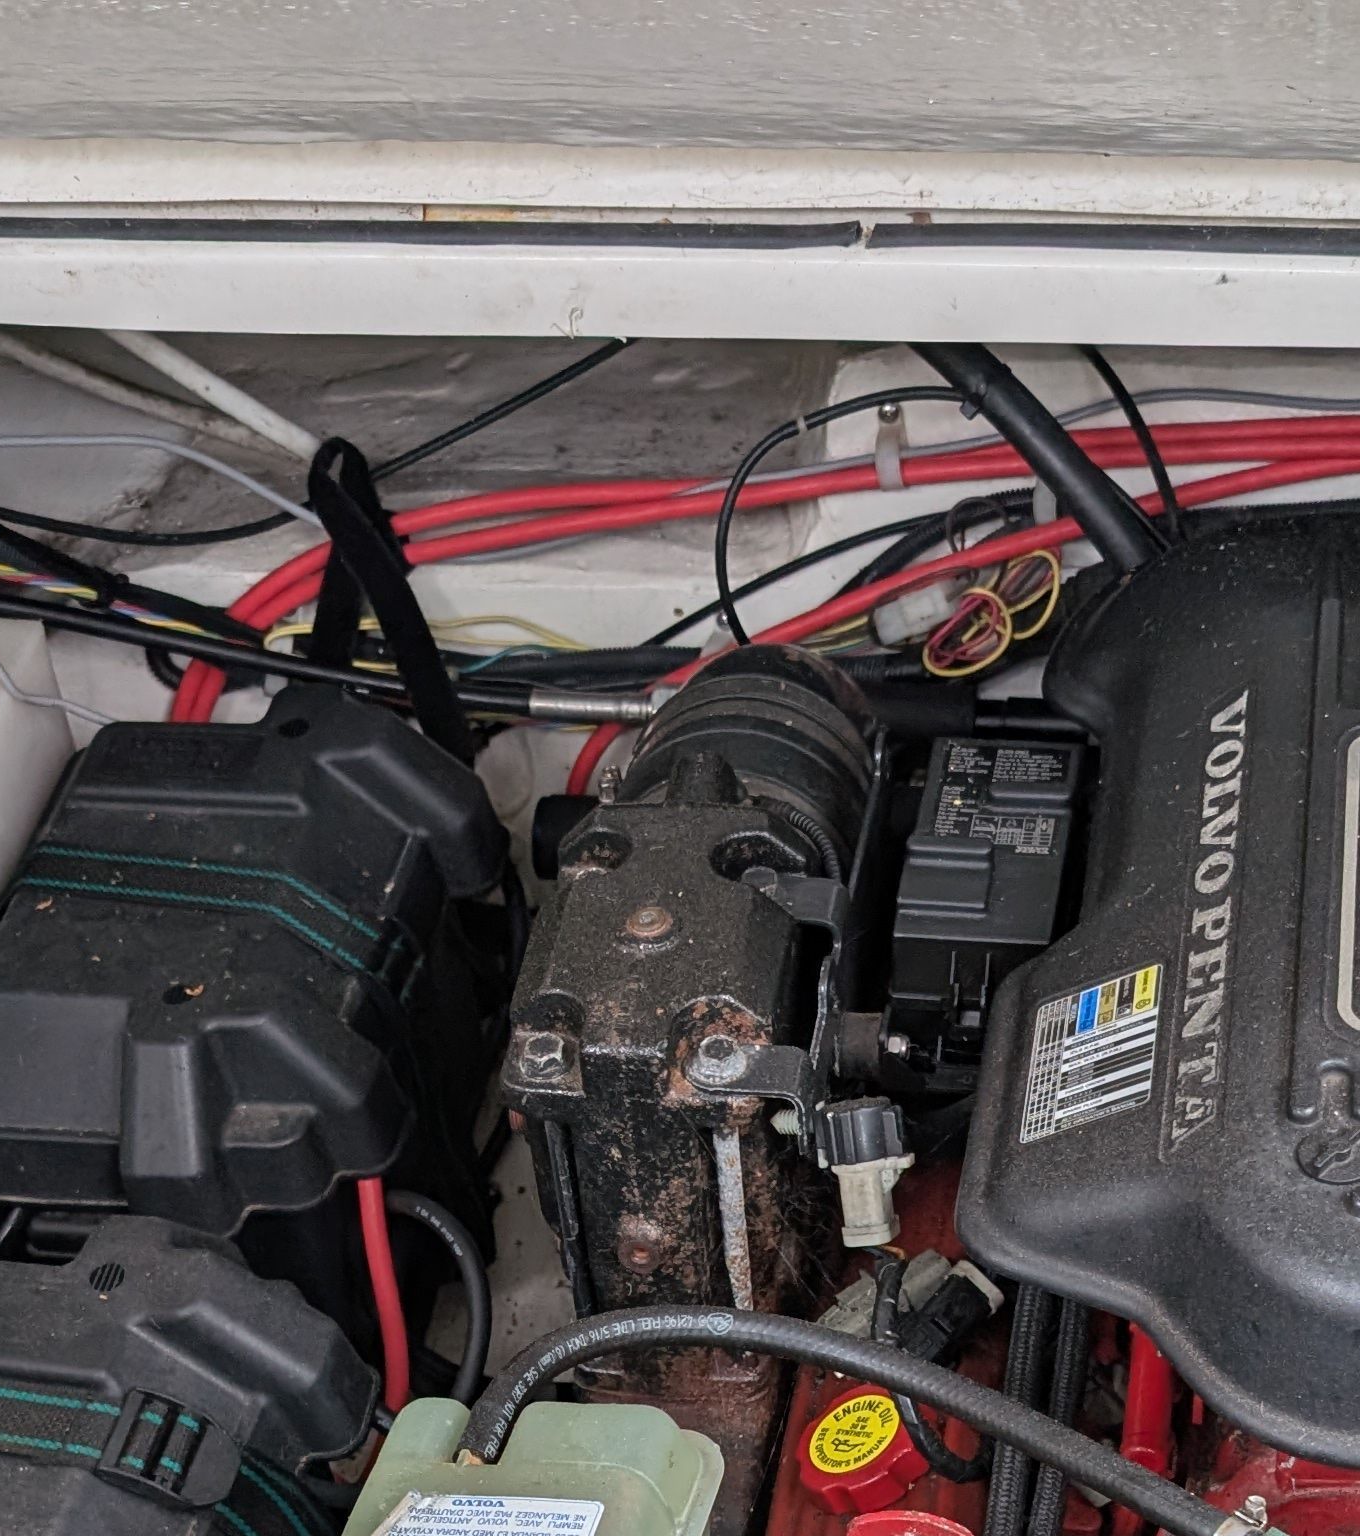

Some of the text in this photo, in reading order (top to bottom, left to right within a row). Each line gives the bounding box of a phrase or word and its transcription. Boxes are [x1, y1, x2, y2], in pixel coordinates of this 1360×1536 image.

[1171, 689, 1249, 1145] VOLVO PENTA
[500, 1398, 514, 1421] NOT
[833, 1400, 893, 1428] ENGINE OIL
[856, 1416, 871, 1424] SAE
[492, 1418, 506, 1441] FOR
[835, 1429, 873, 1438] SYNTHETIC
[483, 1435, 499, 1460] FUEL
[853, 1435, 888, 1465] MANUAL
[452, 1500, 505, 1508] VOLVO
[467, 1509, 492, 1518] AVEC
[495, 1510, 514, 1518] PAS
[515, 1511, 570, 1521] MELANGEZ
[573, 1514, 587, 1522] NE
[477, 1517, 508, 1526] VOLVO
[548, 1520, 584, 1530] REMPLI
[437, 1528, 471, 1536] ANDRA
